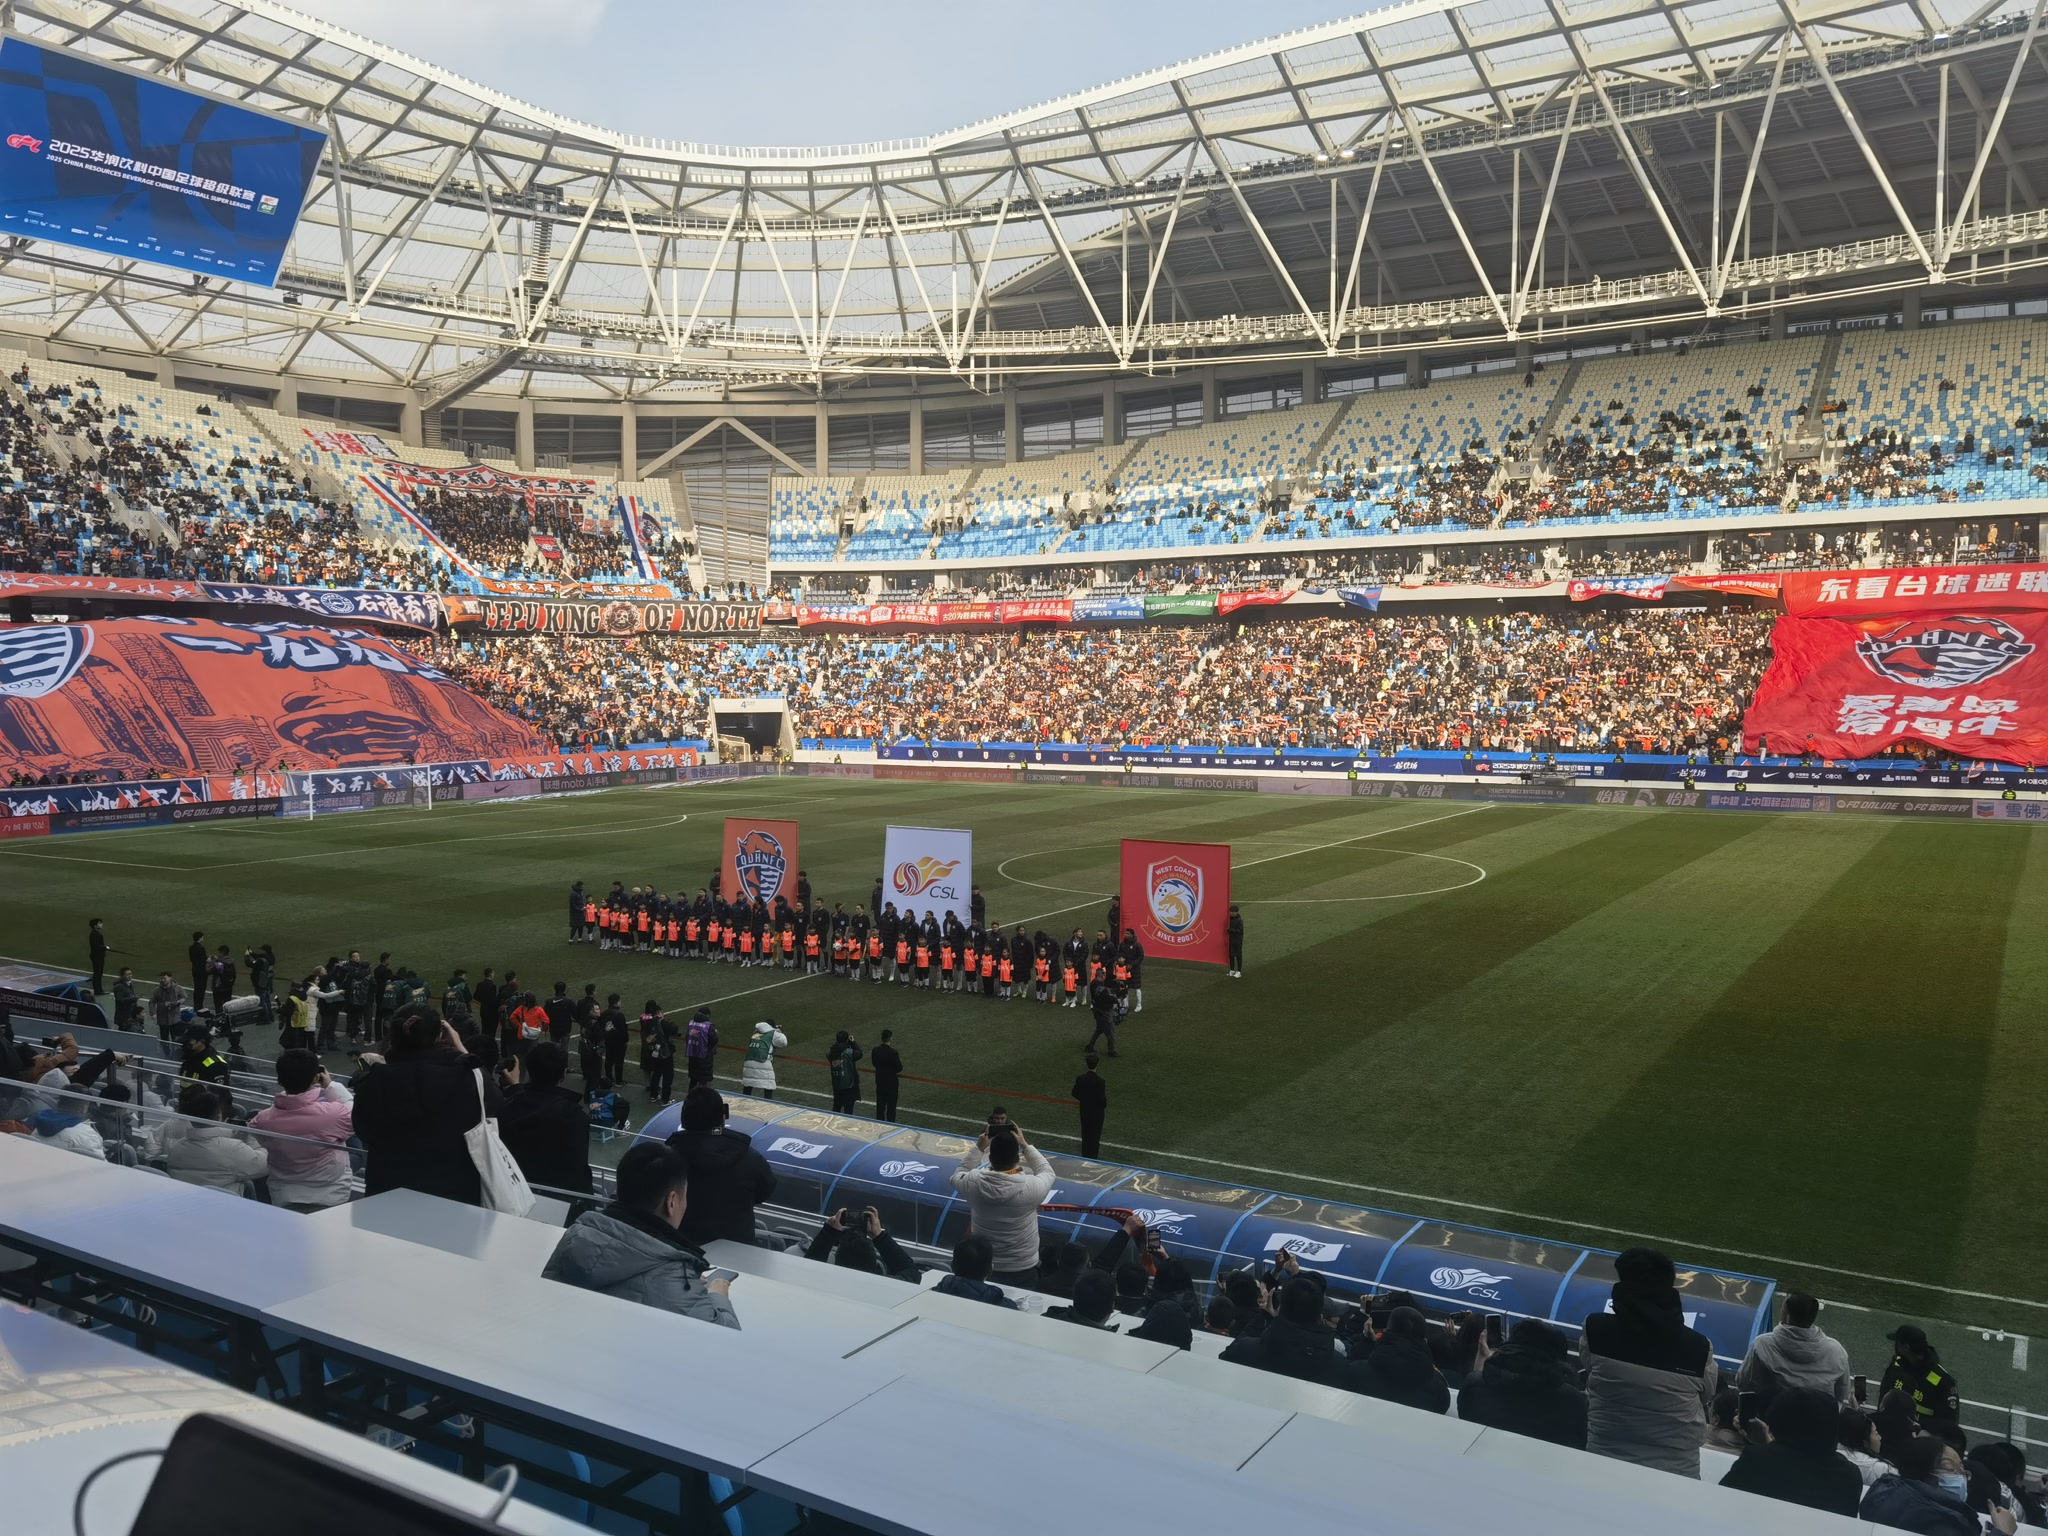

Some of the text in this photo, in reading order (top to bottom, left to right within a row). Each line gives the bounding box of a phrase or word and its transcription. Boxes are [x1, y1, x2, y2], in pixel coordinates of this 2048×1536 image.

[49, 139, 257, 202] 2025华润饮料中国足球超级联赛
[46, 154, 62, 163] 2025
[63, 158, 84, 169] CHINA
[84, 163, 122, 178] RESOURCES
[122, 173, 154, 186] BEVERAGE
[155, 181, 179, 192] CHINESE
[180, 188, 210, 200] FOOTBALL
[210, 195, 229, 204] SUPER
[229, 200, 252, 210] LEAGUE
[1519, 465, 1531, 474] 58
[1286, 482, 1296, 490] 57
[542, 603, 601, 633] KING
[644, 603, 675, 632] OF
[679, 603, 764, 632] NORTH
[543, 779, 559, 790] 联想
[561, 779, 585, 789] moto
[587, 775, 609, 787] AI手机
[1174, 777, 1255, 790] 联想 moto AI手机
[193, 806, 225, 817] ONLINE
[1846, 801, 1900, 810] FC ONLINE
[1913, 803, 1928, 811] FC
[1155, 865, 1196, 878] WEST COAST
[1153, 872, 1198, 891] TRUE WARRIOR
[929, 885, 959, 900] CSL
[1156, 931, 1194, 943] SINCE 2007
[902, 1174, 925, 1185] CSL
[1157, 1224, 1184, 1236] CSL
[1468, 1286, 1502, 1301] CSL
